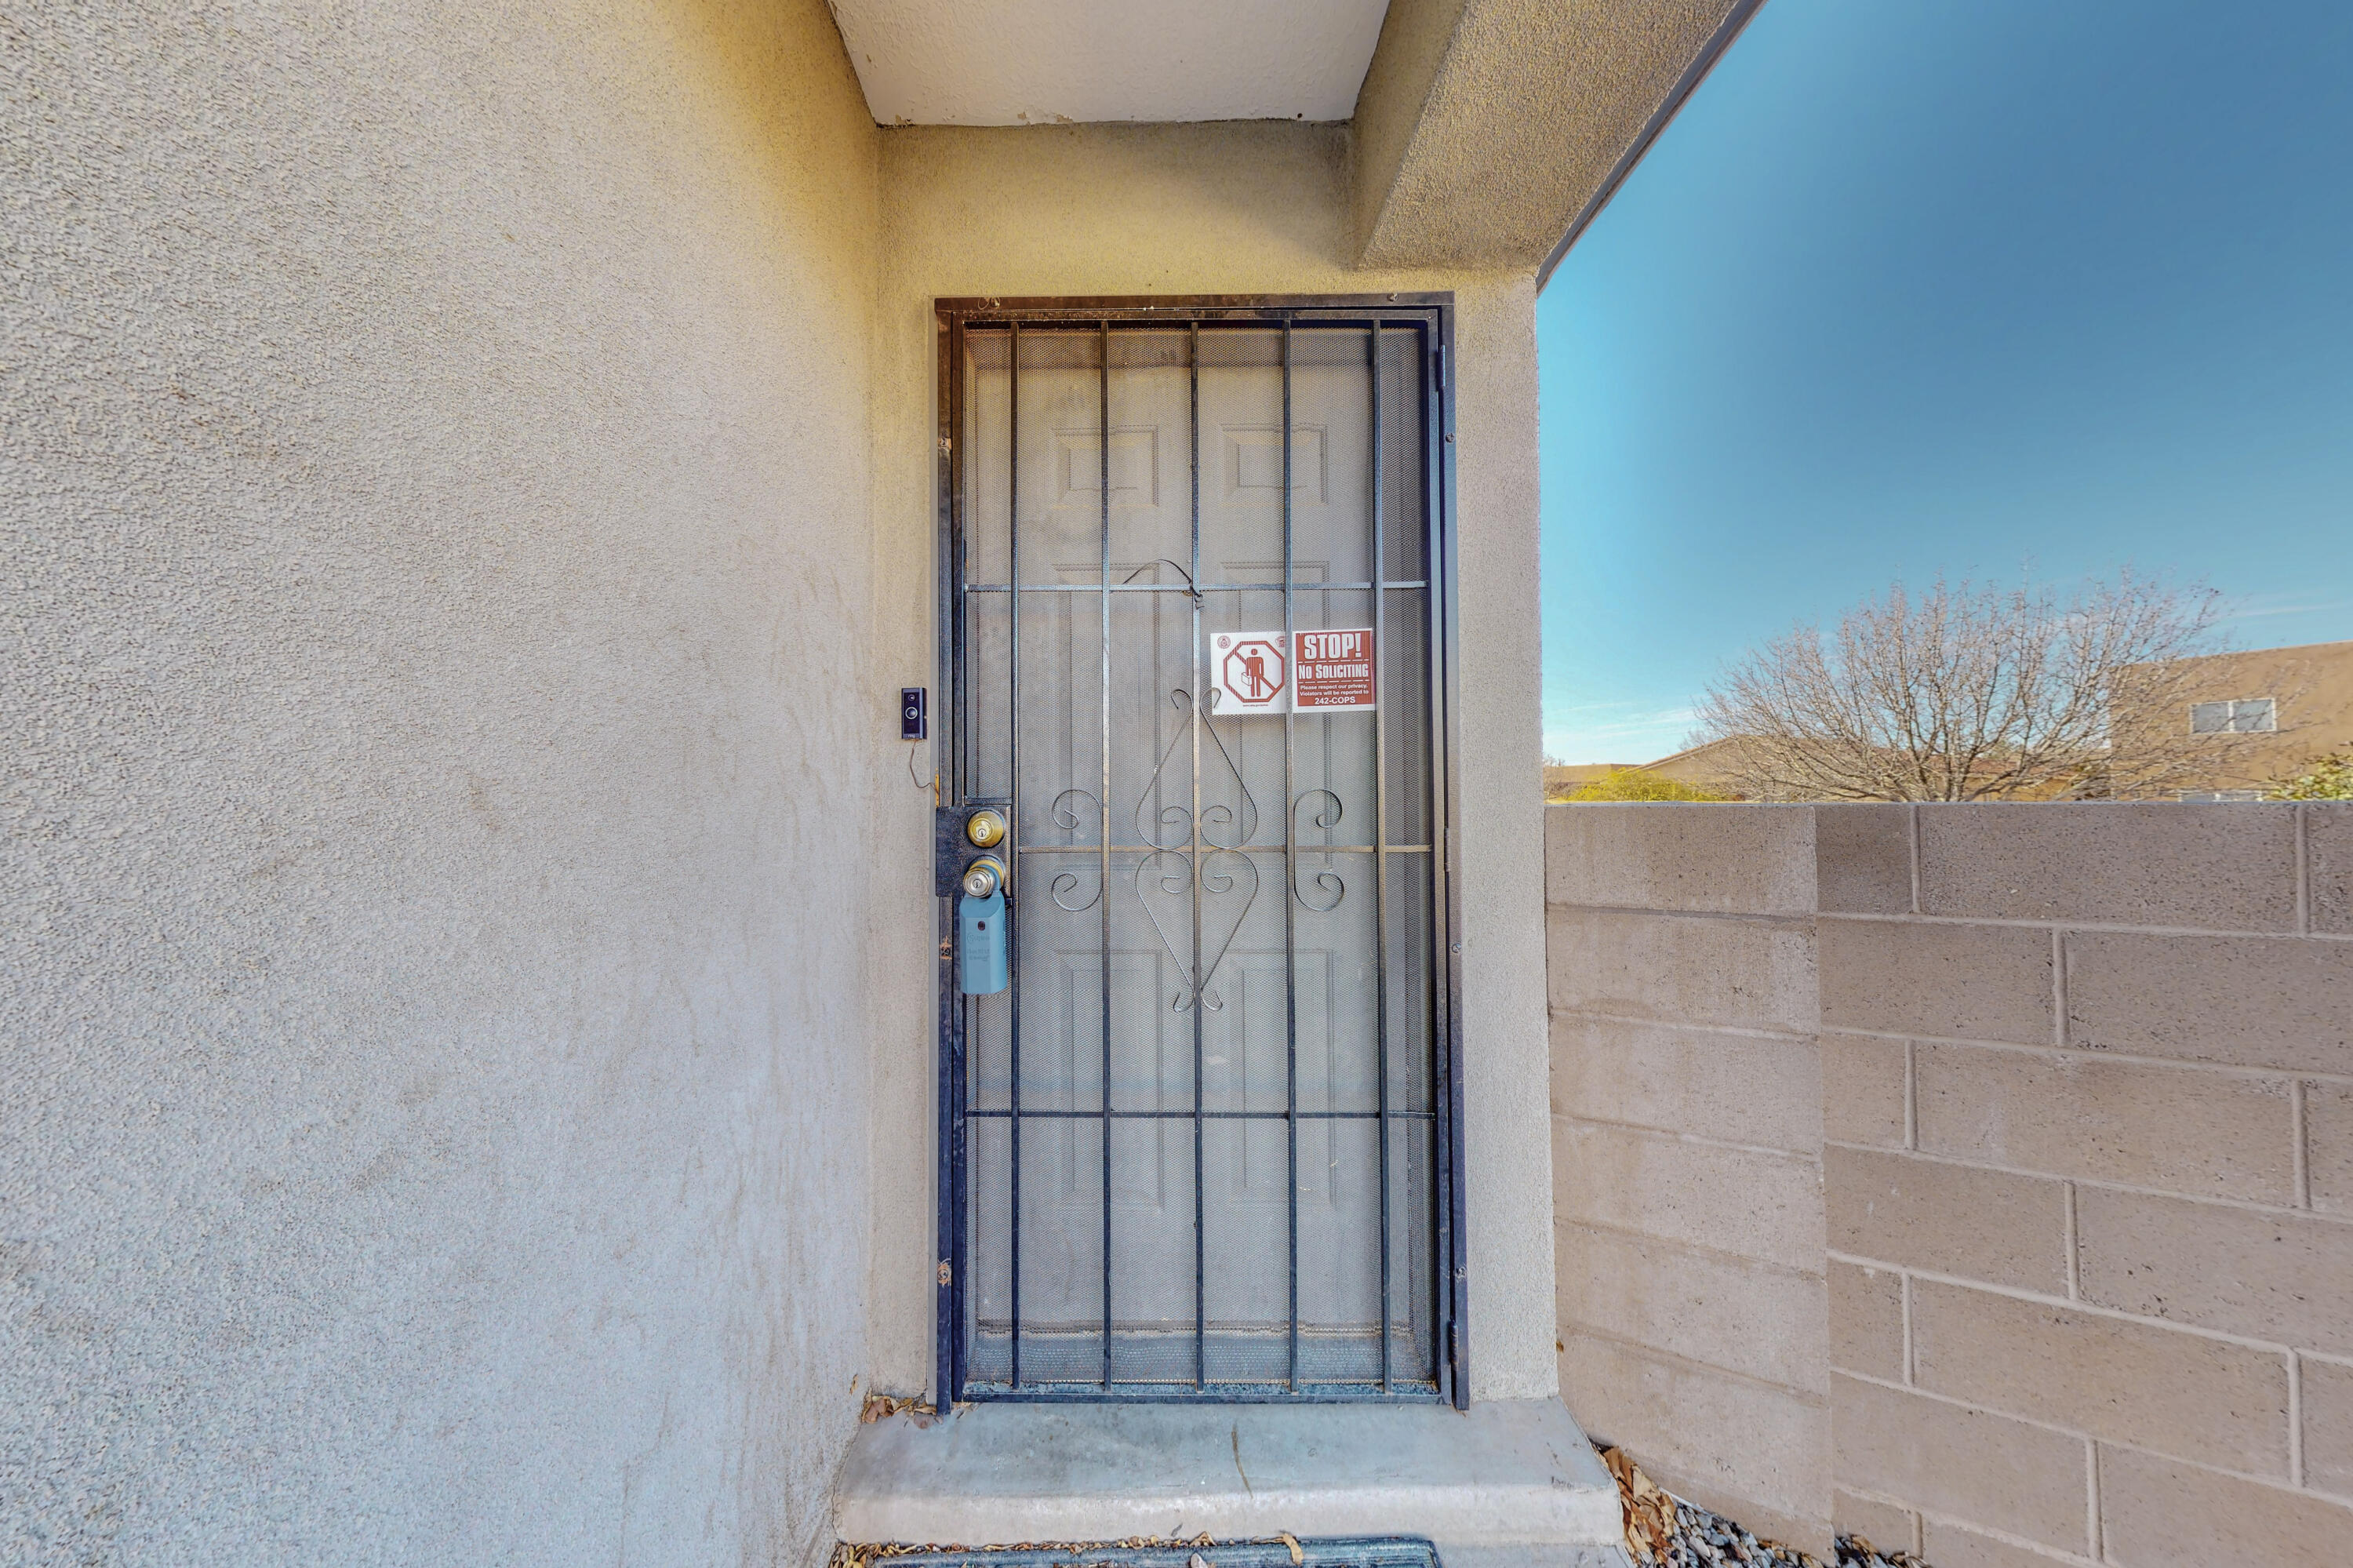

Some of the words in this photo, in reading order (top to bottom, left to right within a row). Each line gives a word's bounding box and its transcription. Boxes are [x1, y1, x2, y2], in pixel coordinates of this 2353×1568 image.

[1304, 633, 1362, 660] STOP!
[1315, 664, 1369, 679] SOLICITING
[1315, 696, 1356, 704] 242-COPS
